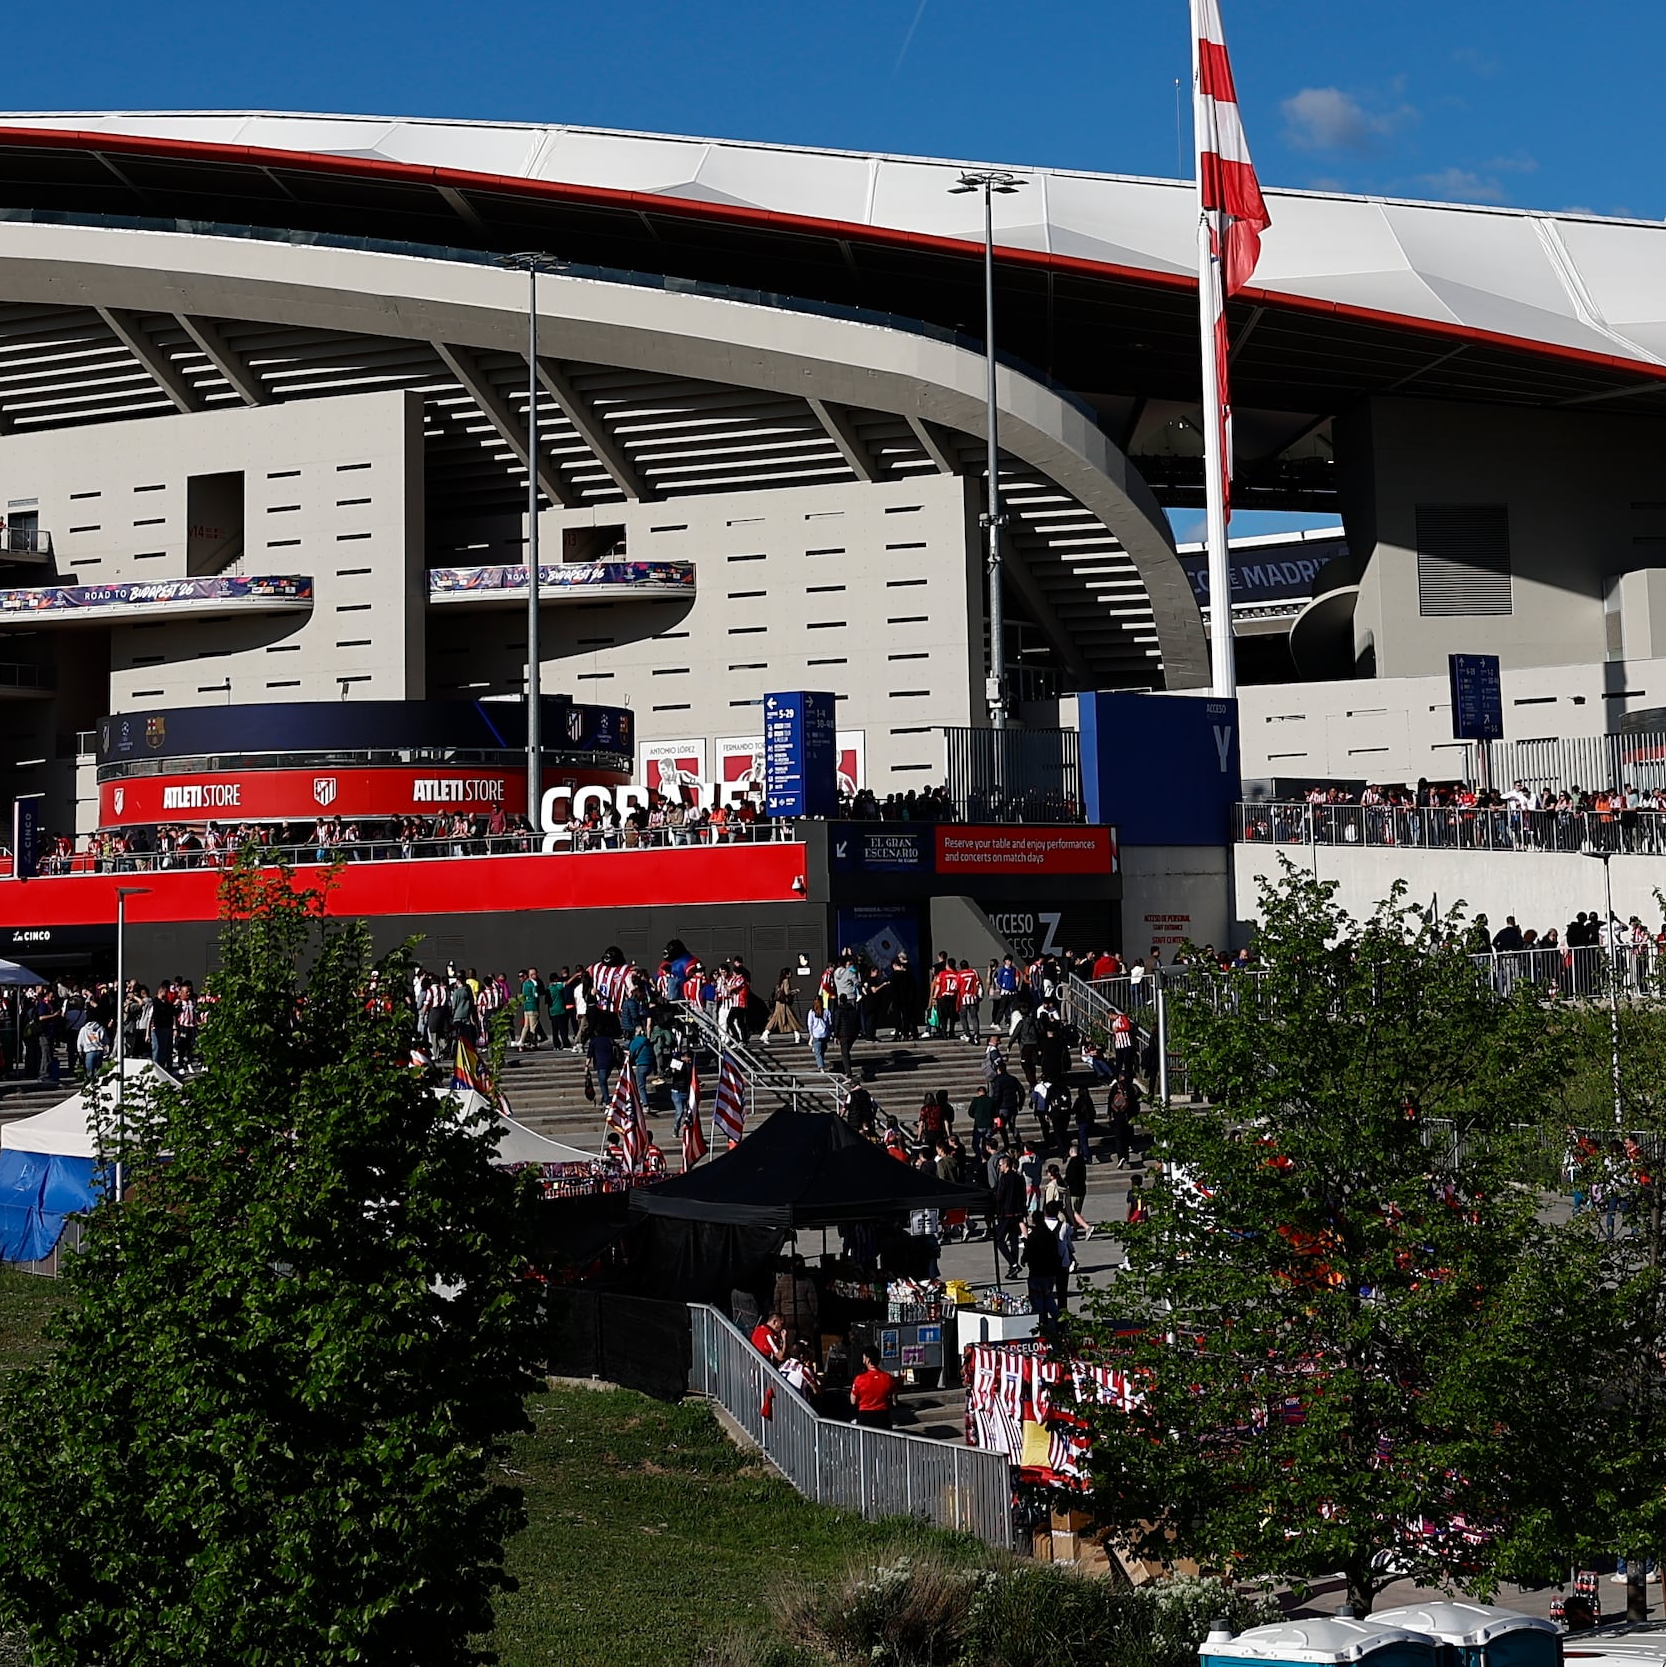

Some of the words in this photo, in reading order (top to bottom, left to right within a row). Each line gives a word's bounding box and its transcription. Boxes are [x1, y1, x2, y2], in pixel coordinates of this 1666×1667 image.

[85, 590, 110, 601] ROAD
[114, 590, 126, 598] TO
[129, 583, 179, 602] BUDAPEST
[650, 747, 676, 756] ANTONIO
[677, 745, 696, 755] LÓPEZ
[723, 742, 752, 752] FERNANDO
[1212, 725, 1231, 773] Y
[163, 785, 202, 809] ATLETI
[202, 784, 241, 807] STORE
[413, 780, 463, 802] ATLETI
[465, 780, 505, 801] STORE
[24, 813, 32, 848] CINCO
[871, 837, 884, 847] EL
[885, 837, 912, 847] GRAN
[944, 837, 973, 848] Reserve
[974, 839, 991, 850] your
[992, 838, 1011, 849] table
[1012, 838, 1026, 849] and
[1026, 838, 1046, 851] enjoy
[1046, 838, 1095, 851] performances
[864, 847, 919, 858] ESCENARIO
[944, 851, 959, 862] and
[960, 851, 992, 863] concerts
[992, 854, 1002, 863] on
[1003, 852, 1026, 863] match
[1027, 852, 1044, 865] days
[988, 913, 1034, 934] ACCESO
[24, 930, 51, 942] CINCO
[1038, 912, 1064, 958] Z
[964, 977, 972, 991] 7
